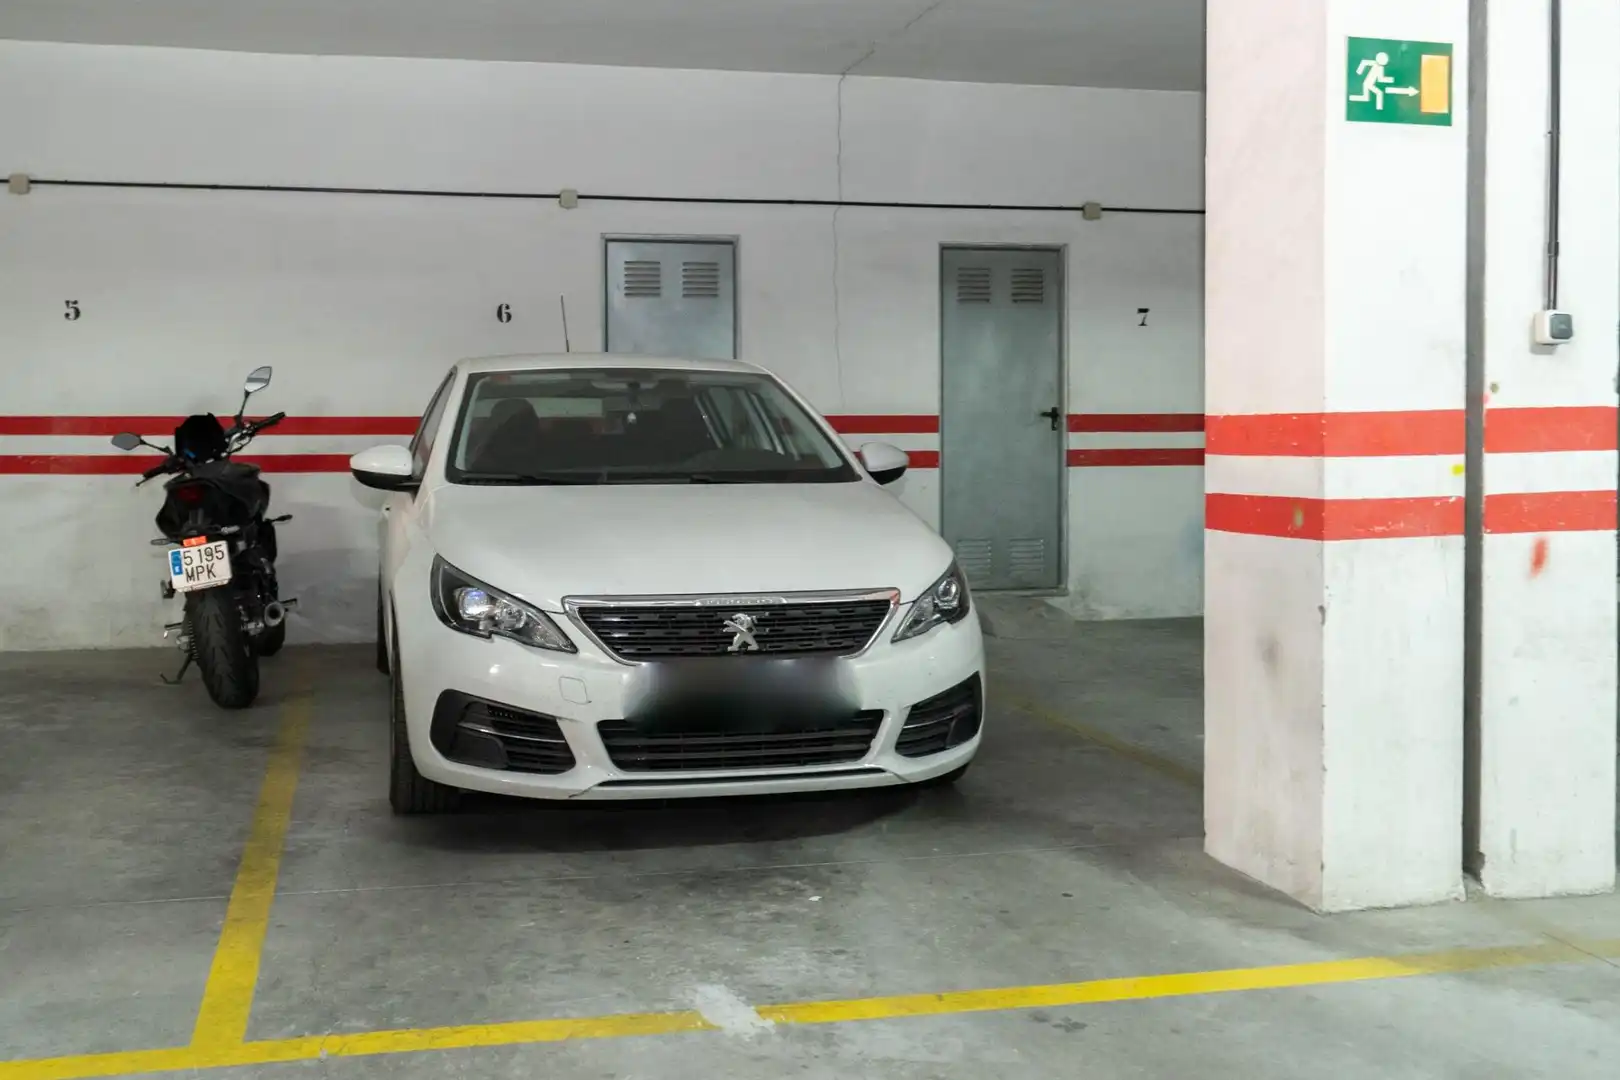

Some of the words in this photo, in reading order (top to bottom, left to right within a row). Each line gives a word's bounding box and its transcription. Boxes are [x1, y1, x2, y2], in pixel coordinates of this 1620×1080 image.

[64, 299, 81, 321] 5
[496, 303, 512, 323] 6
[1137, 307, 1150, 326] 7
[183, 544, 225, 566] 5195
[185, 562, 216, 582] MPK
